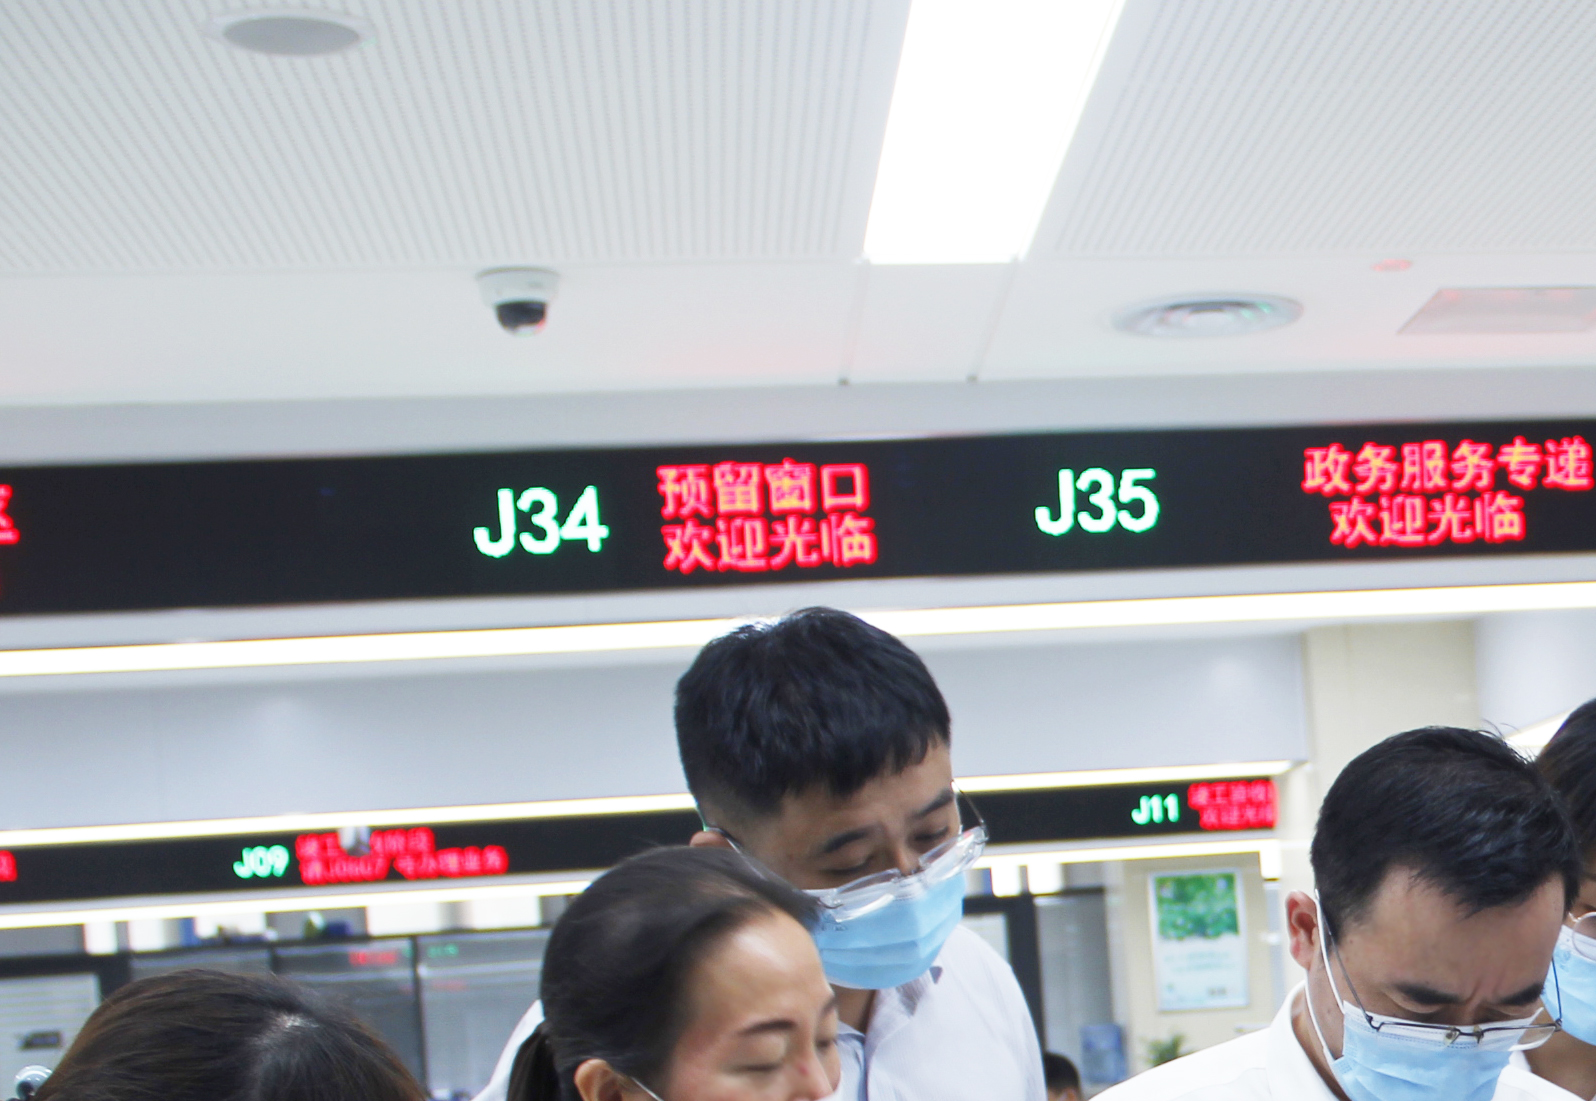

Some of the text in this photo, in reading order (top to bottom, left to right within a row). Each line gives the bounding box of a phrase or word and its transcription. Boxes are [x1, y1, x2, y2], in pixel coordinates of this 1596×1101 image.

[656, 458, 869, 520] 预留窗口
[1301, 436, 1594, 497] 政务服务专递
[473, 485, 609, 558] J34
[1034, 467, 1161, 536] J35
[1329, 491, 1526, 548] 欢迎光临
[660, 511, 878, 574] 欢迎光临
[1131, 793, 1180, 825] J11
[232, 845, 290, 879] J09
